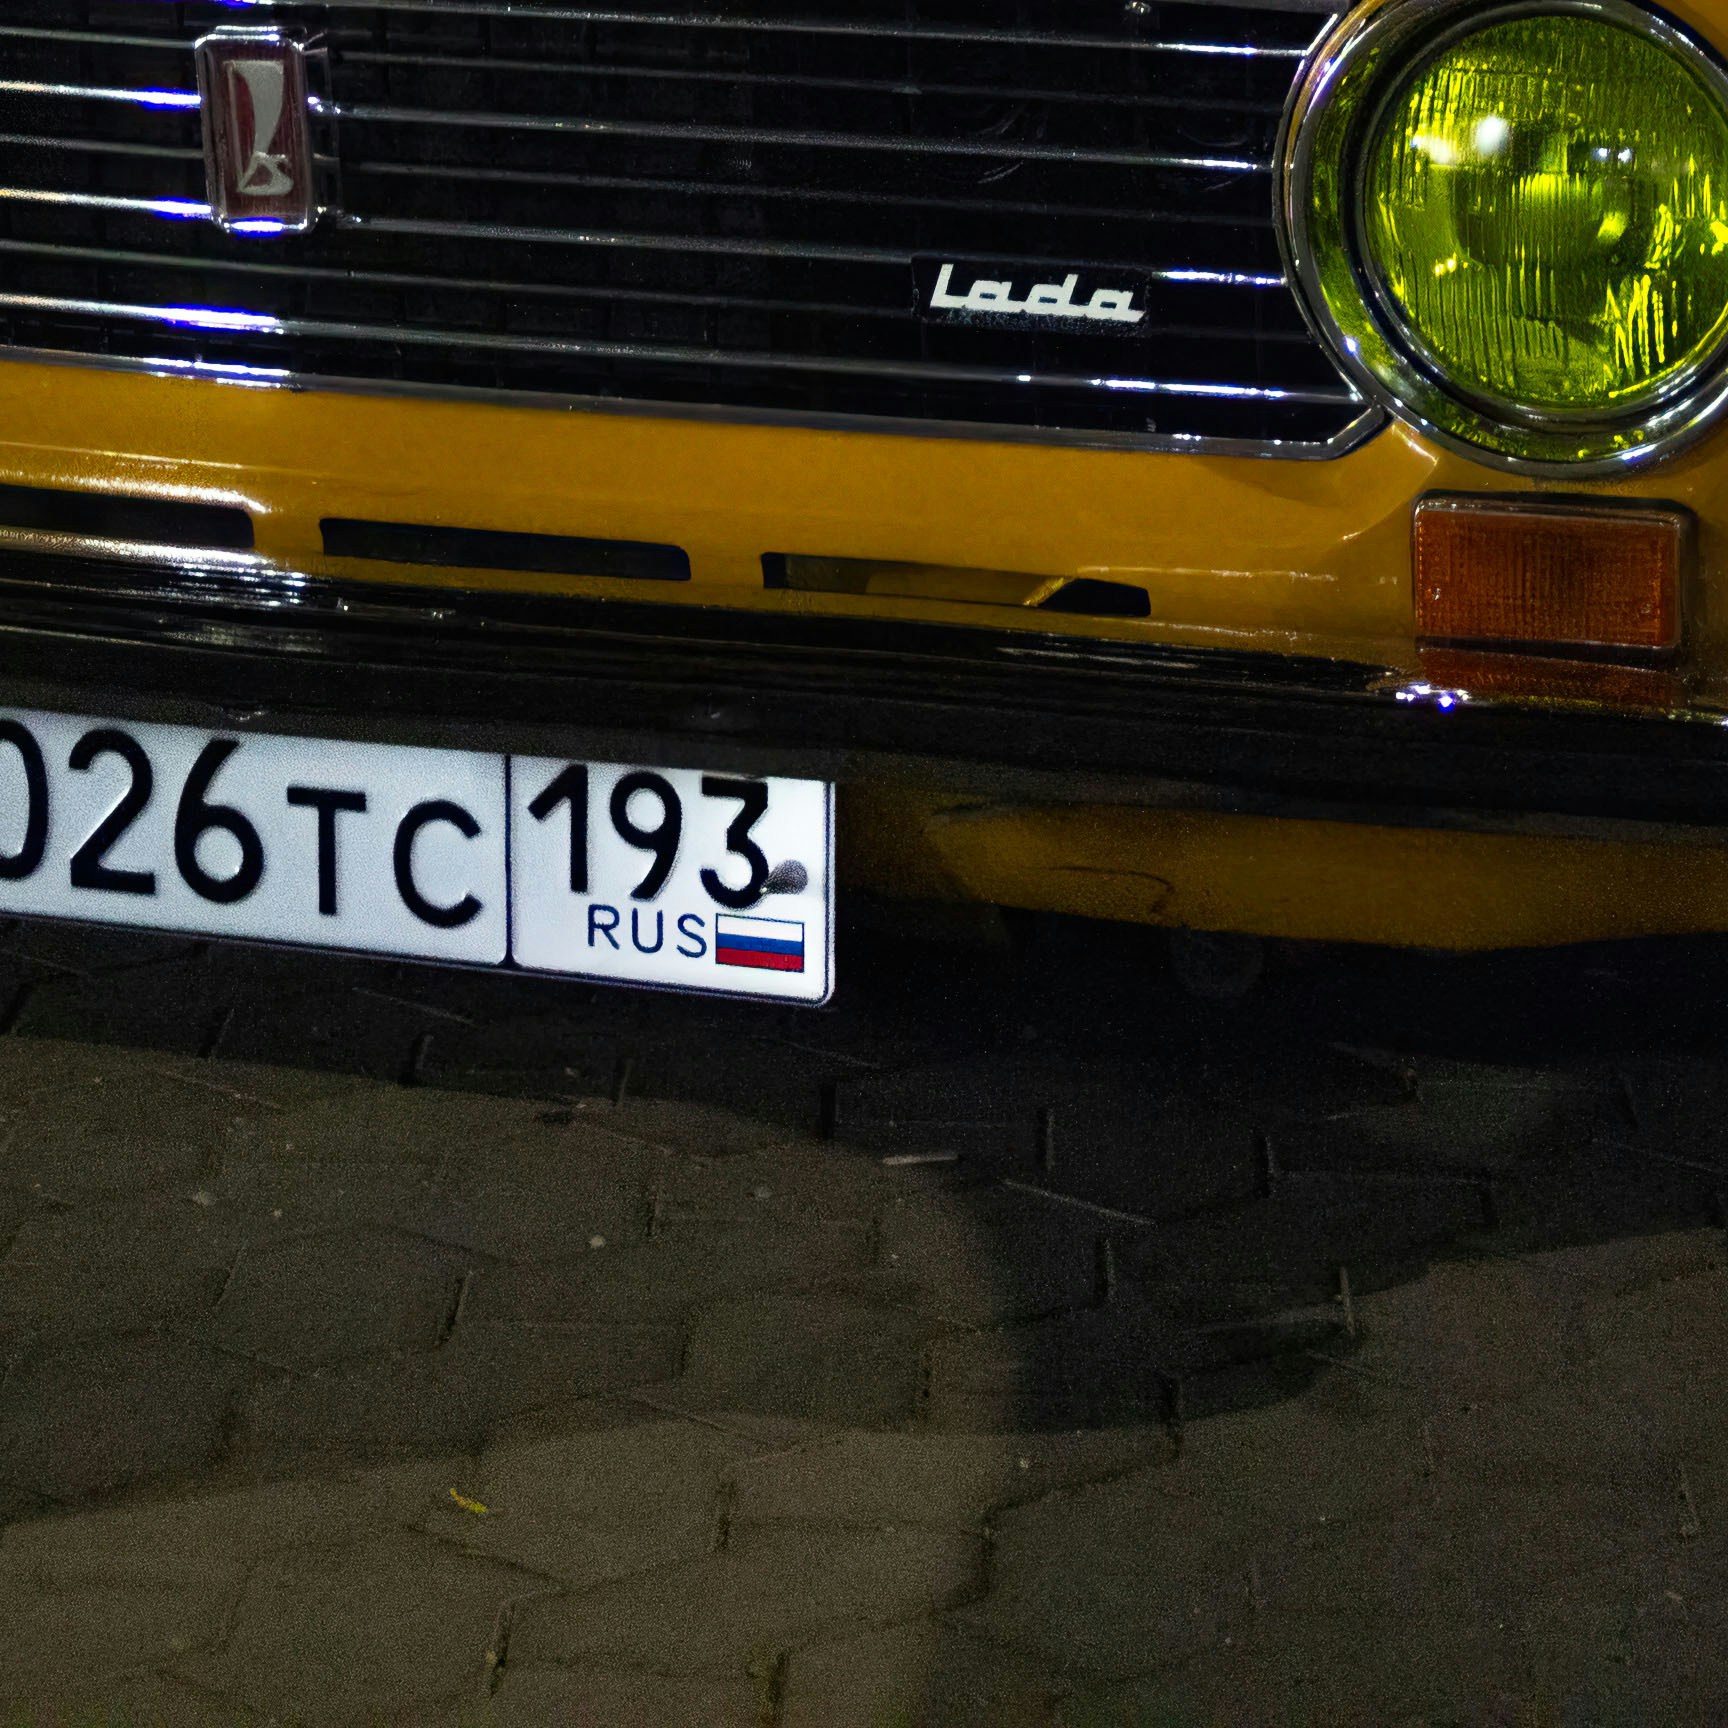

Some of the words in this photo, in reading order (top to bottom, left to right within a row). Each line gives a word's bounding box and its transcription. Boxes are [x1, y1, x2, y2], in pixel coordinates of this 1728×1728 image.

[929, 263, 1146, 322] Lada
[527, 763, 771, 909] 193
[585, 903, 709, 960] RUS
